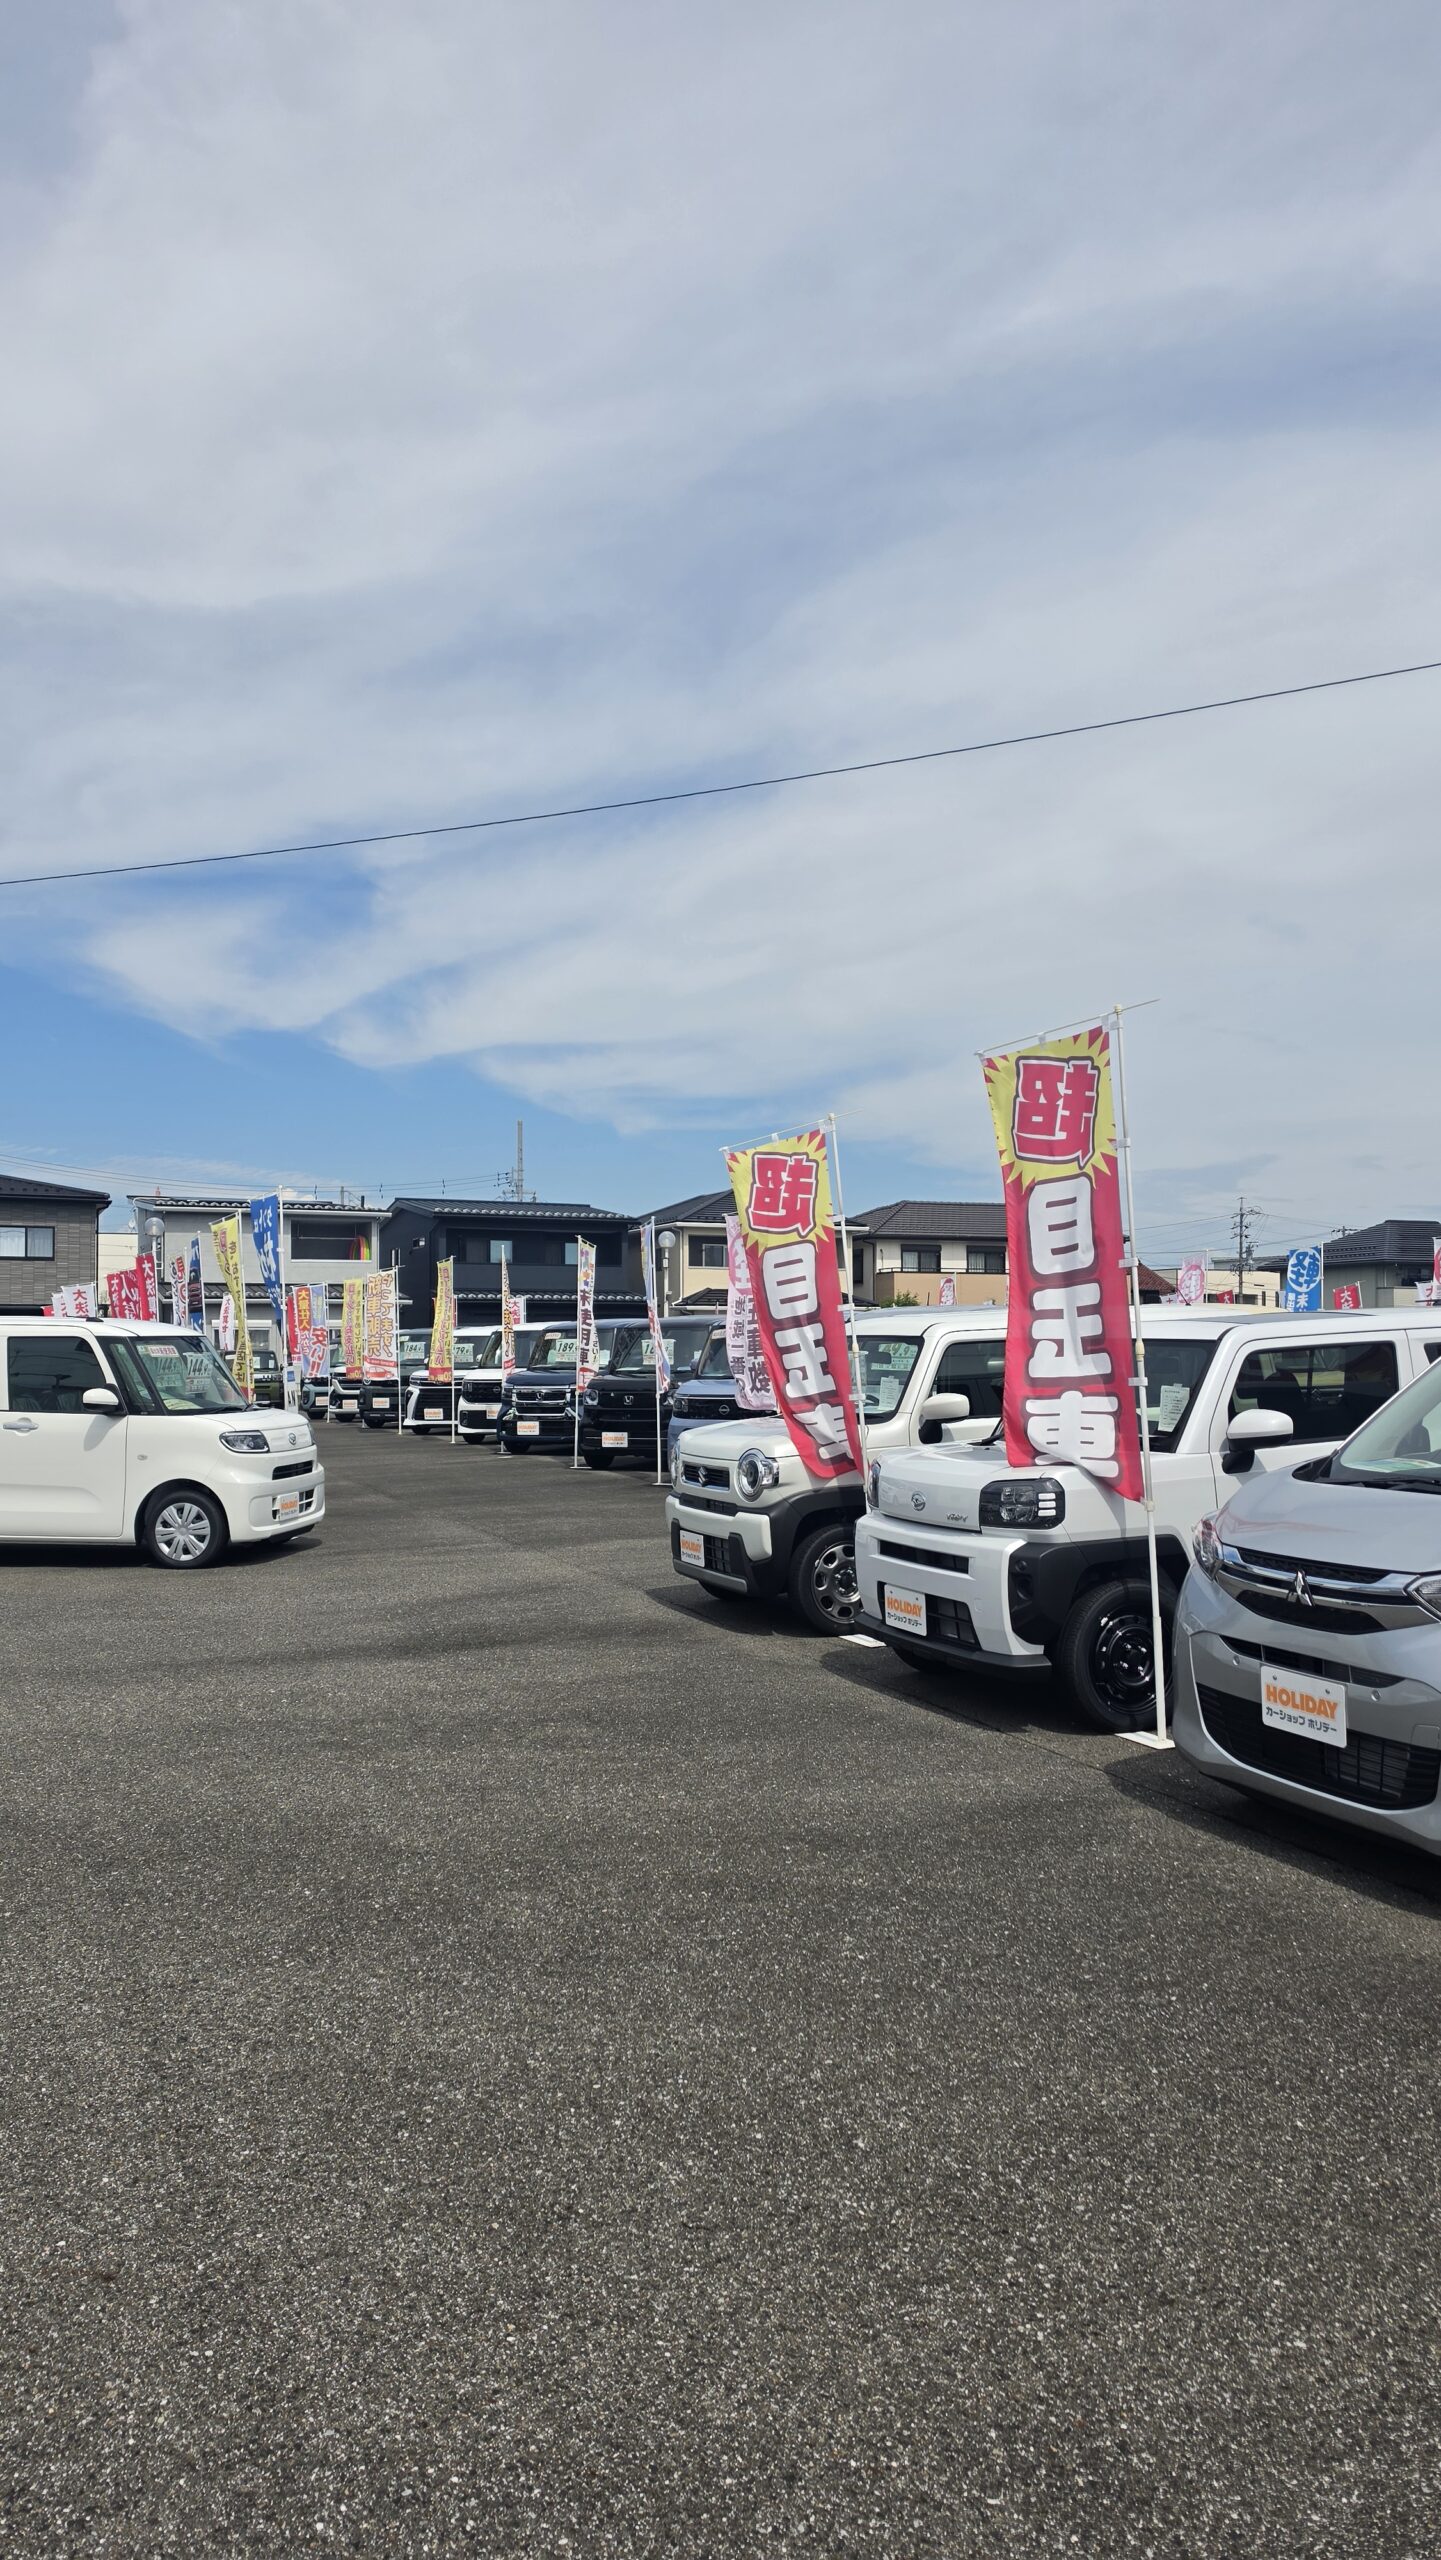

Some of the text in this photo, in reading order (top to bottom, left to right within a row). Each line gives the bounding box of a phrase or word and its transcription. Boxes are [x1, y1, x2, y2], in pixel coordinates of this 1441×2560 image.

[887, 1596, 922, 1618] HOLIDAY
[887, 1611, 907, 1623] カーショップ
[1265, 1684, 1338, 1720] HOLIDAY
[1265, 1706, 1337, 1733] カーショップ ホリデー
